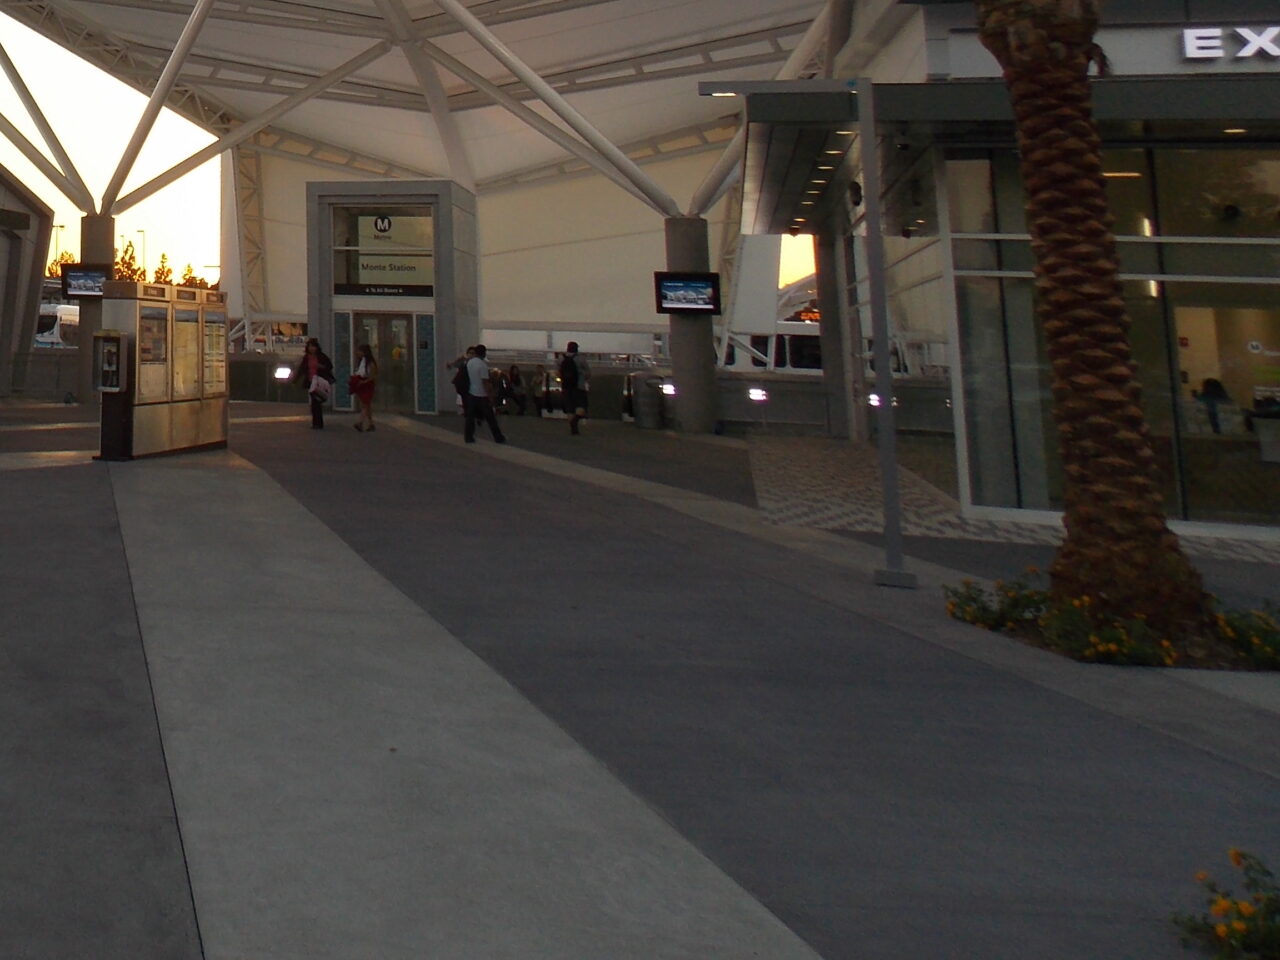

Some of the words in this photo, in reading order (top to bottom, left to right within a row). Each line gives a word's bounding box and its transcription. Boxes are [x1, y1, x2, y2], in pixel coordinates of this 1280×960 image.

[1183, 27, 1280, 58] EX
[361, 263, 386, 271] Monte
[388, 263, 416, 272] Station
